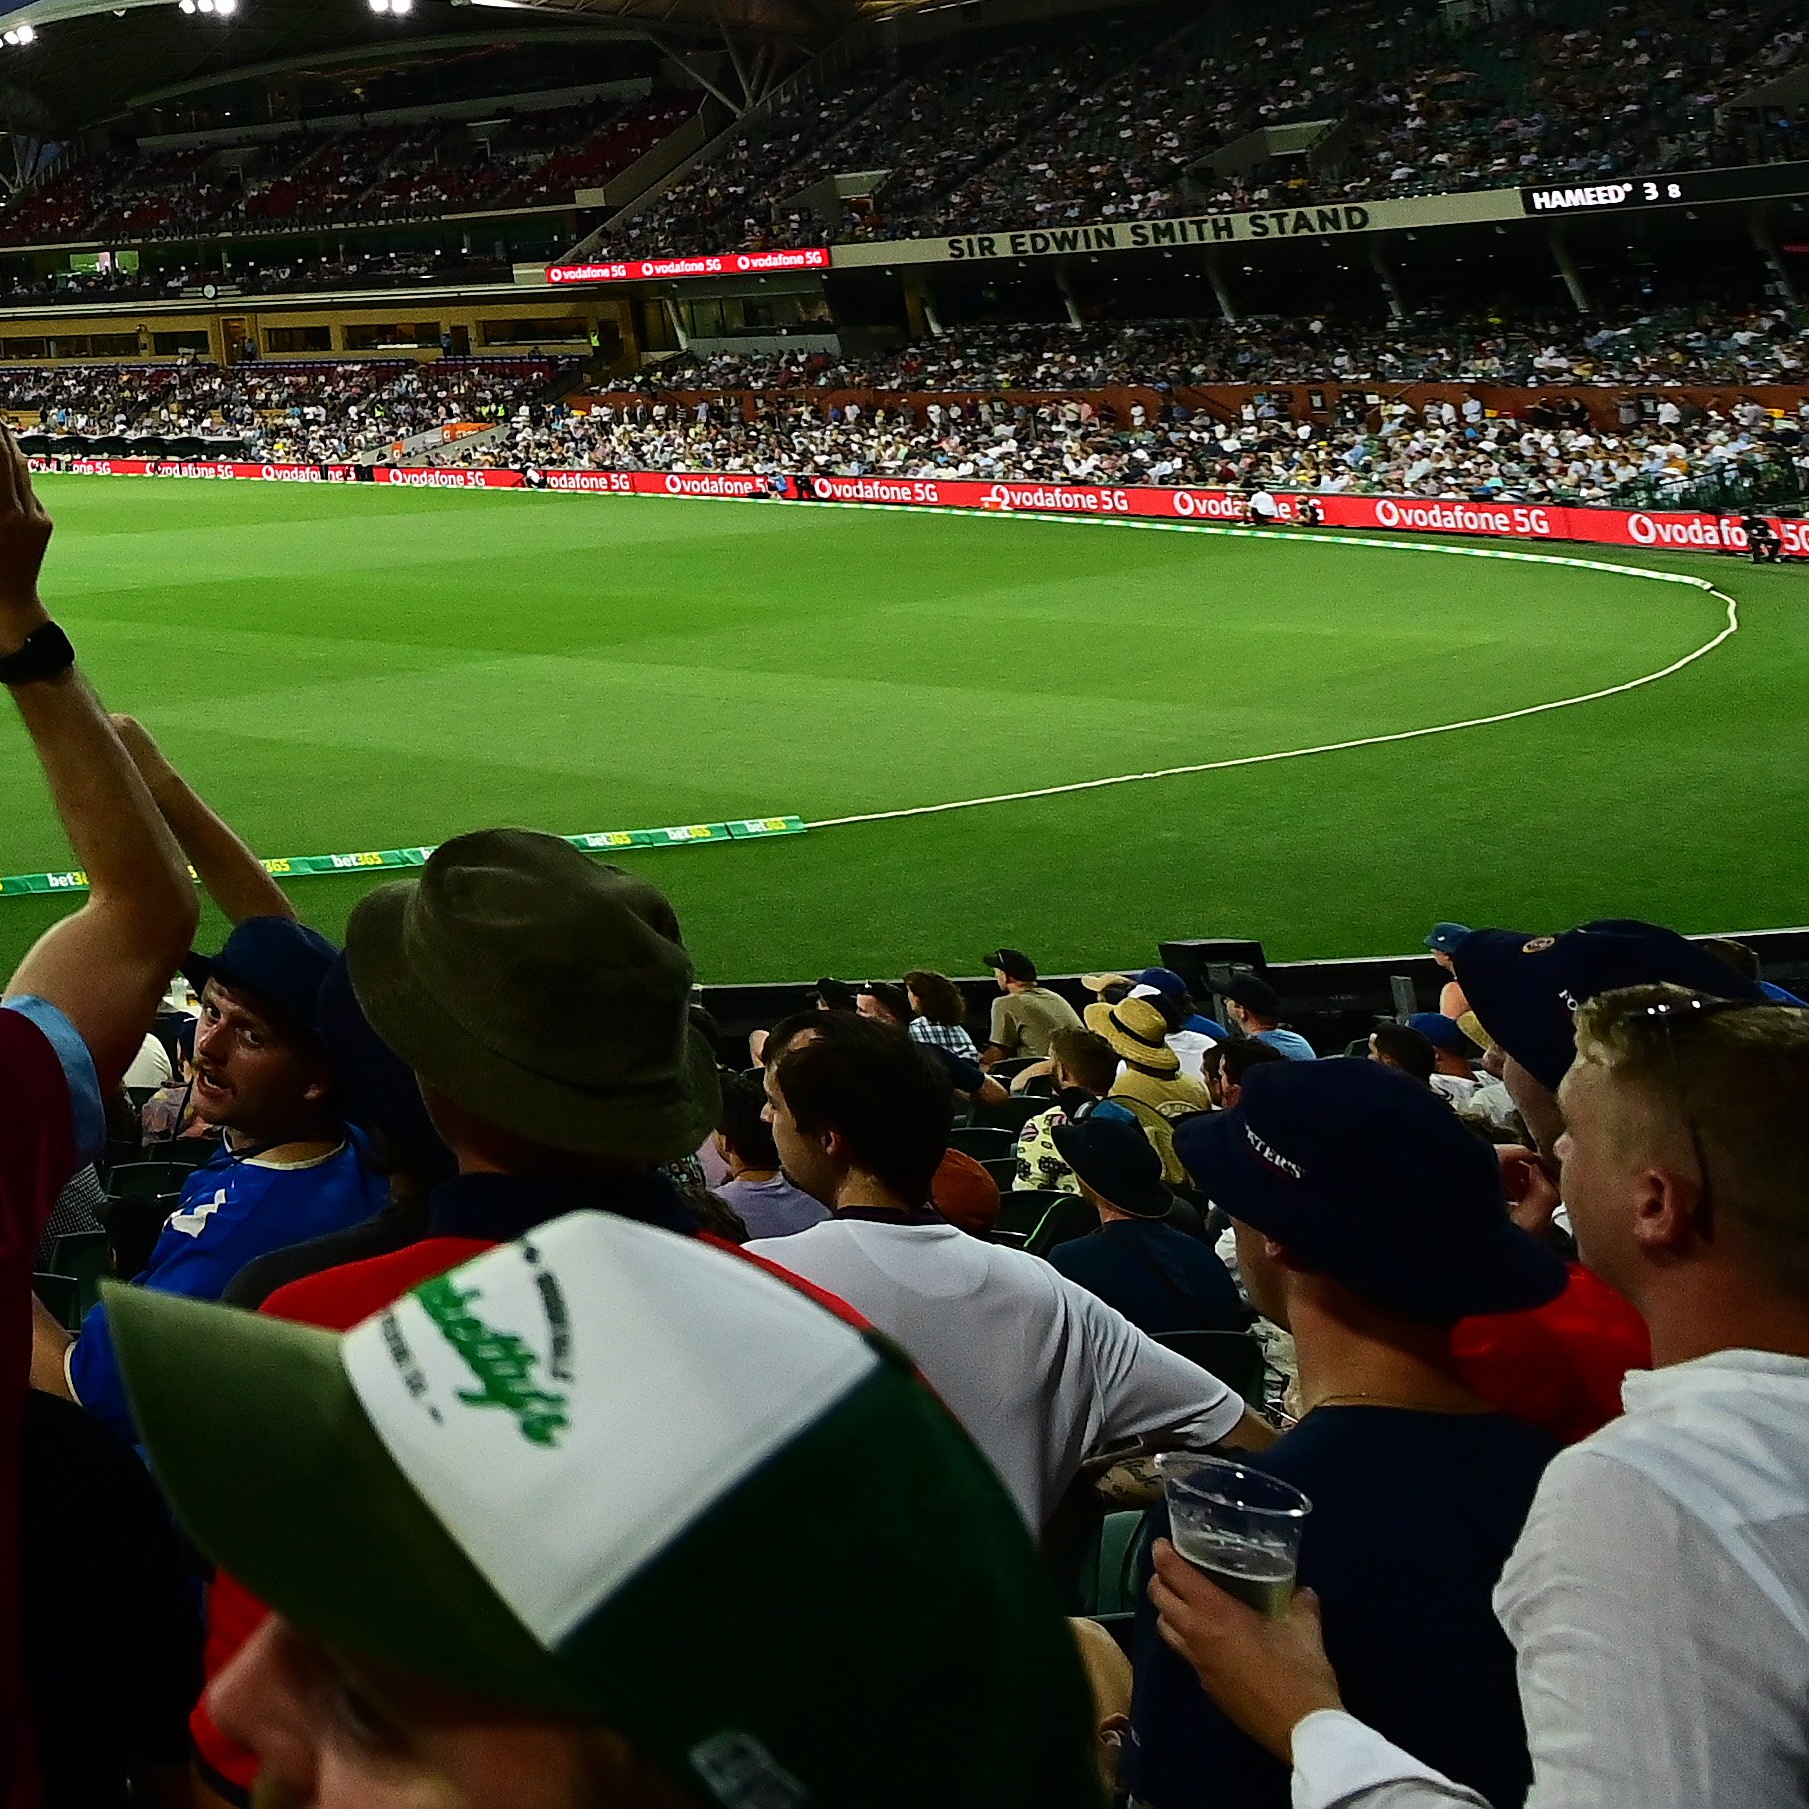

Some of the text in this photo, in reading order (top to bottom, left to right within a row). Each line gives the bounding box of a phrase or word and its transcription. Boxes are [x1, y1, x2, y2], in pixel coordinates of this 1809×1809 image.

[1643, 182, 1659, 201] 3
[1668, 183, 1681, 198] 8
[948, 206, 1370, 259] SIR EDWIN SMITH STAND
[654, 259, 722, 274] vodafone 5G
[751, 251, 822, 267] vodafone 5G
[563, 265, 627, 280] vodafone 5G
[95, 462, 111, 474] 5G
[216, 464, 233, 477] 5G
[401, 469, 486, 487] vodafone 5G
[610, 474, 630, 490] 5G
[683, 475, 753, 494] vodafone
[834, 480, 939, 502] vodafone 5G
[1010, 487, 1129, 512] vodafone 5G
[1399, 504, 1551, 534] vodafone 5G
[666, 825, 711, 840] bet365
[744, 817, 787, 832] bet365
[584, 833, 632, 847] bet365
[331, 853, 384, 868] bet365
